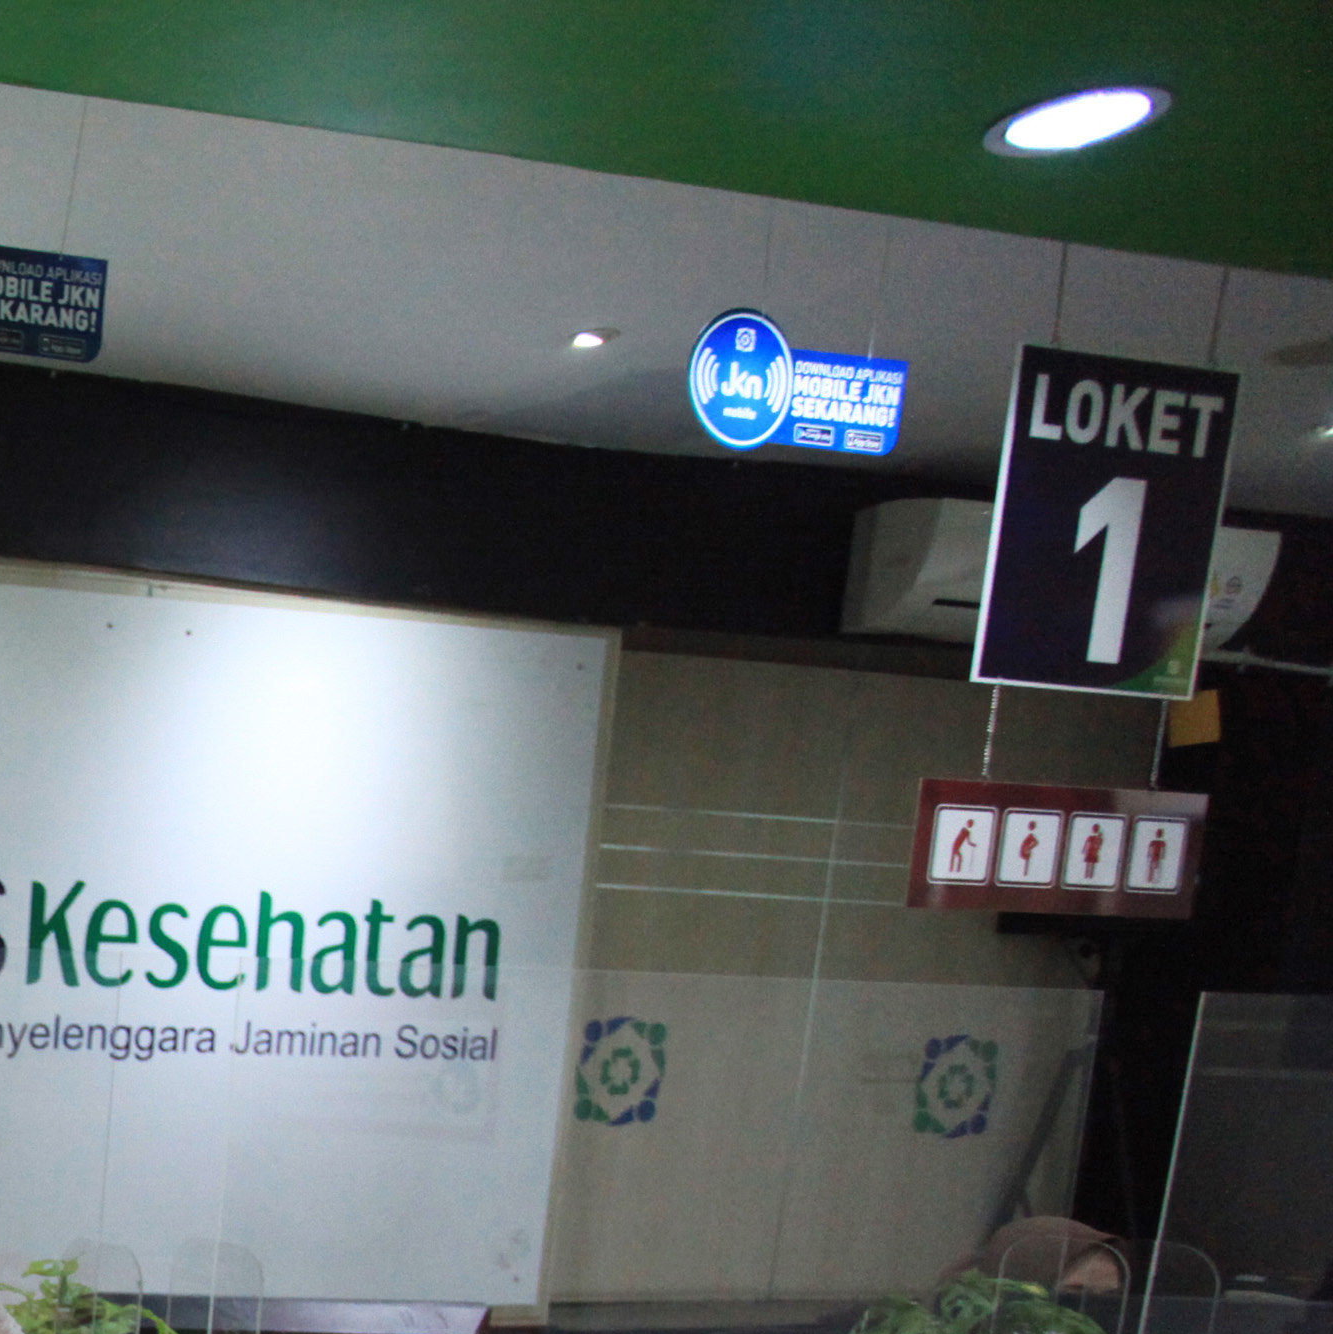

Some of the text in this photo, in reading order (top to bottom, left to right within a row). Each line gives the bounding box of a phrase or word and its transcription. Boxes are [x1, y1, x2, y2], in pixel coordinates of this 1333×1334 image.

[46, 265, 103, 285] APLIKASI
[58, 285, 100, 309] JKN
[794, 361, 903, 385] DOWNLOAD APLIKASI
[793, 375, 900, 406] MOBILE JKN
[791, 396, 895, 427] SEKARANG!
[1029, 373, 1224, 458] LOKET
[1074, 477, 1148, 664] 1
[25, 880, 500, 1000] Kesehatan
[232, 1018, 381, 1060] Jaminan
[393, 1023, 497, 1062] Sosial
